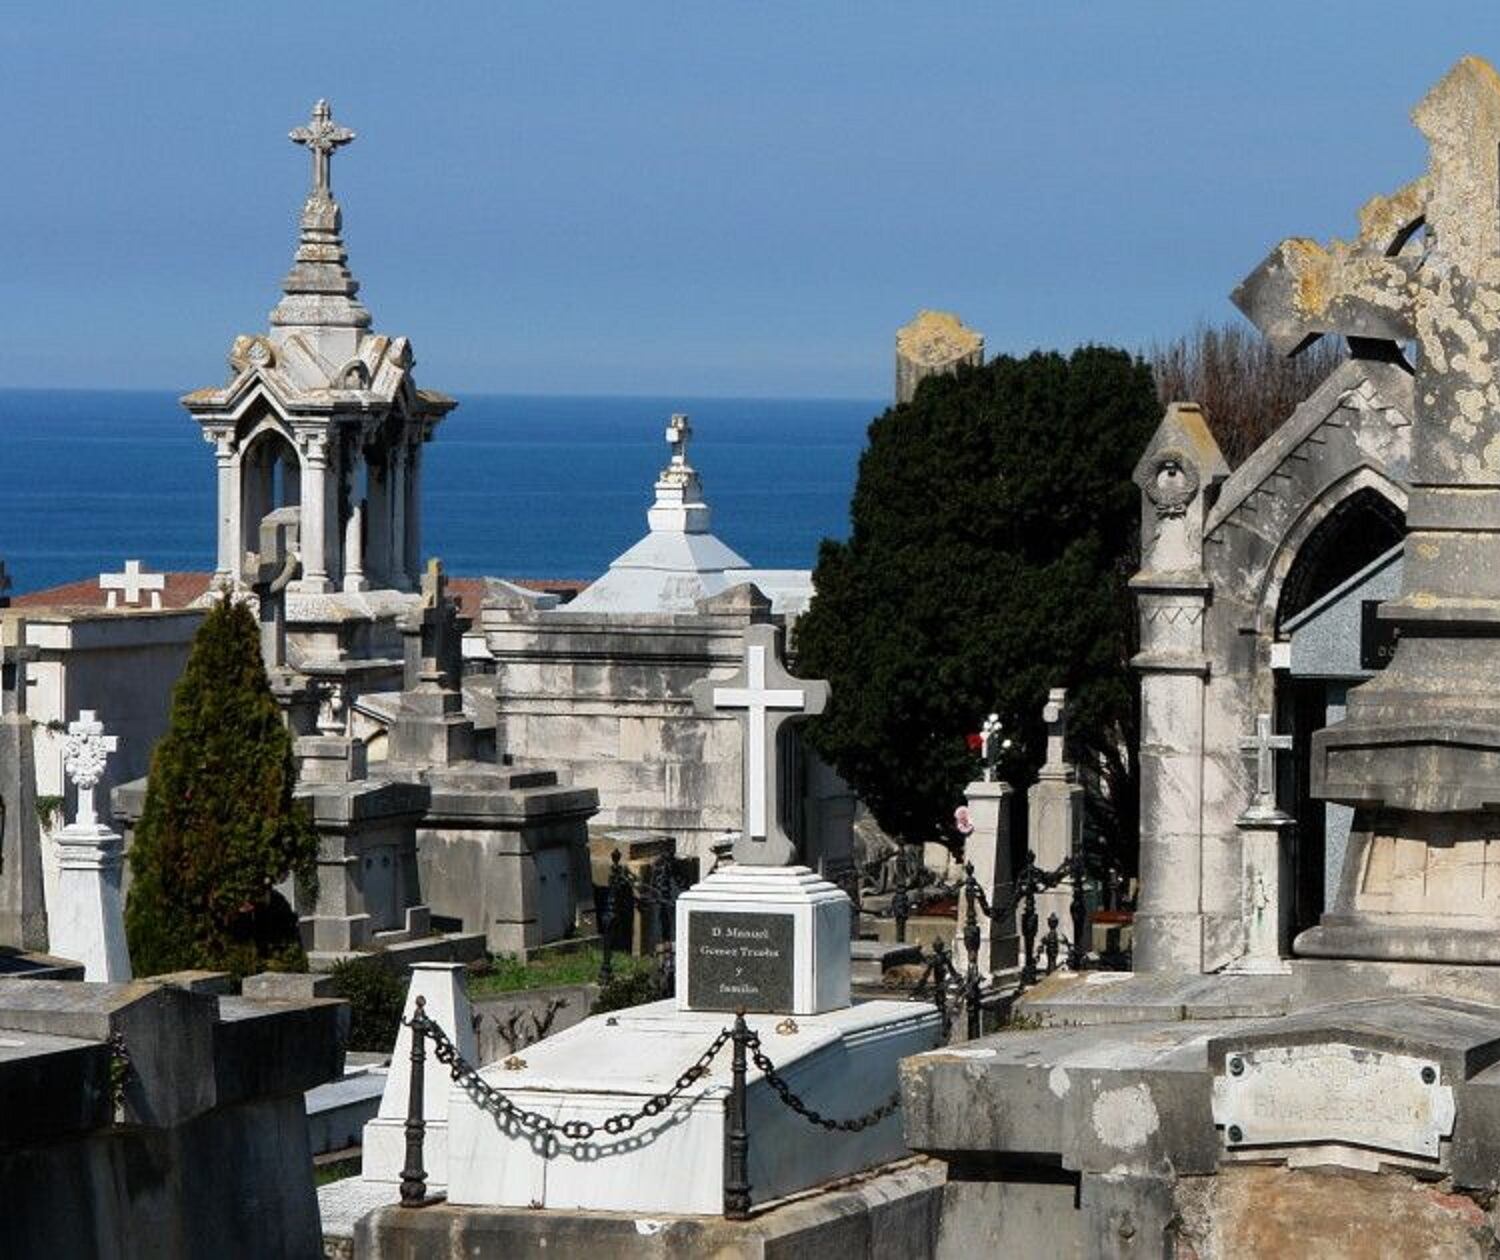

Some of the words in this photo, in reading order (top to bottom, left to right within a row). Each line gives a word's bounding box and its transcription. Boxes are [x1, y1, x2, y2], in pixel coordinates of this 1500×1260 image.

[725, 927, 769, 938] Manuel
[735, 966, 744, 977] y
[719, 983, 759, 993] familia
